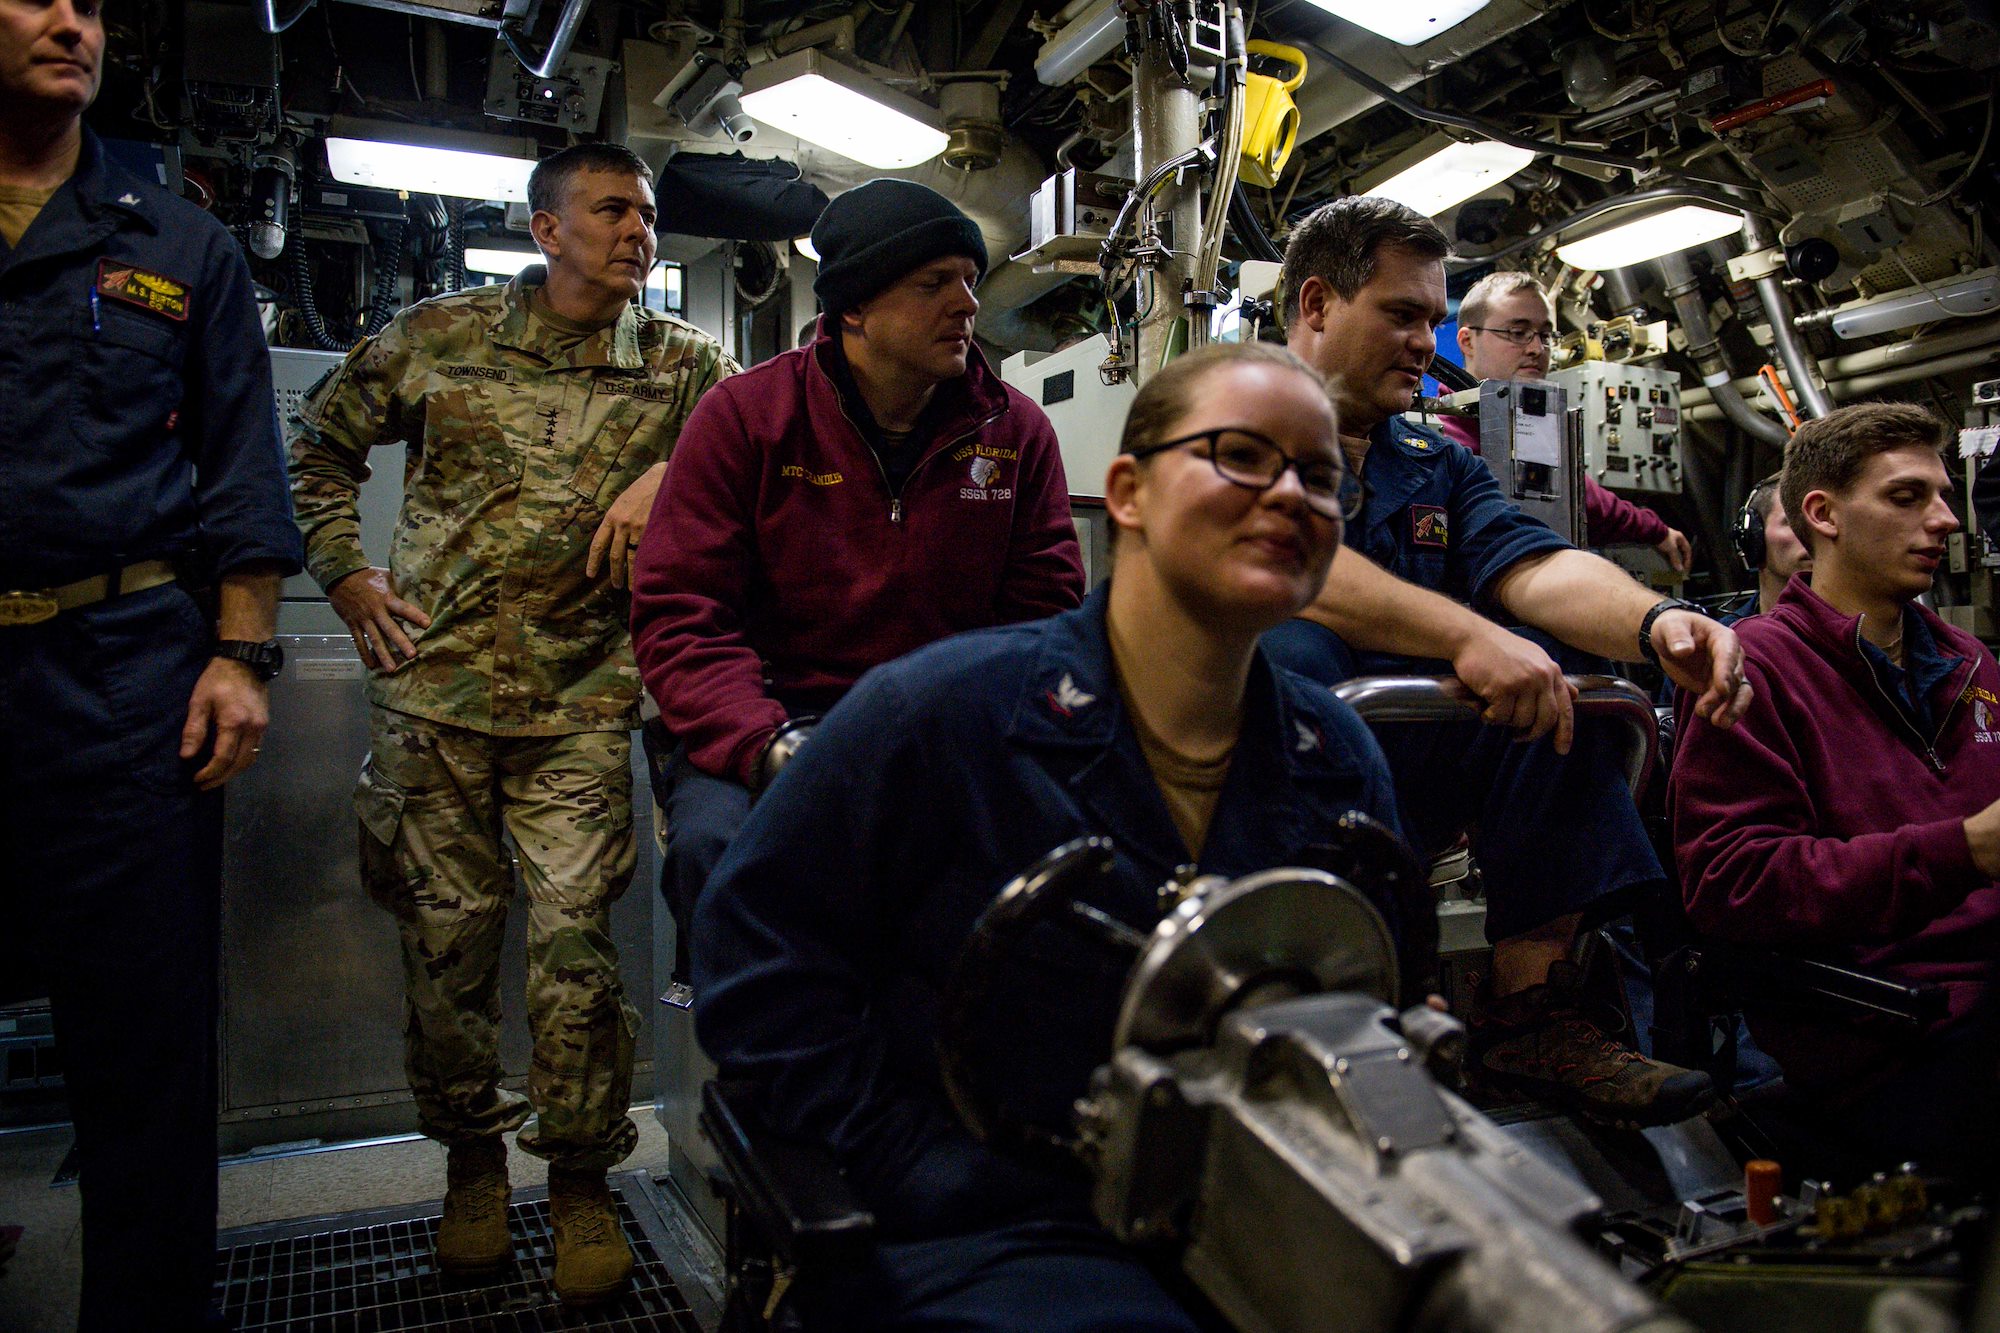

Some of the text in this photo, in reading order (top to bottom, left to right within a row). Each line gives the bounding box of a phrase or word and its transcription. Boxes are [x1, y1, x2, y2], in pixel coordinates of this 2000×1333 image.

[149, 291, 184, 312] BURTON
[149, 299, 164, 310] CO
[447, 366, 507, 381] TOWNSEND
[605, 383, 666, 399] U.S. ARMY
[952, 443, 1018, 462] USS FLORIDA
[781, 465, 803, 477] MTC
[959, 488, 1012, 501] SSGN 728
